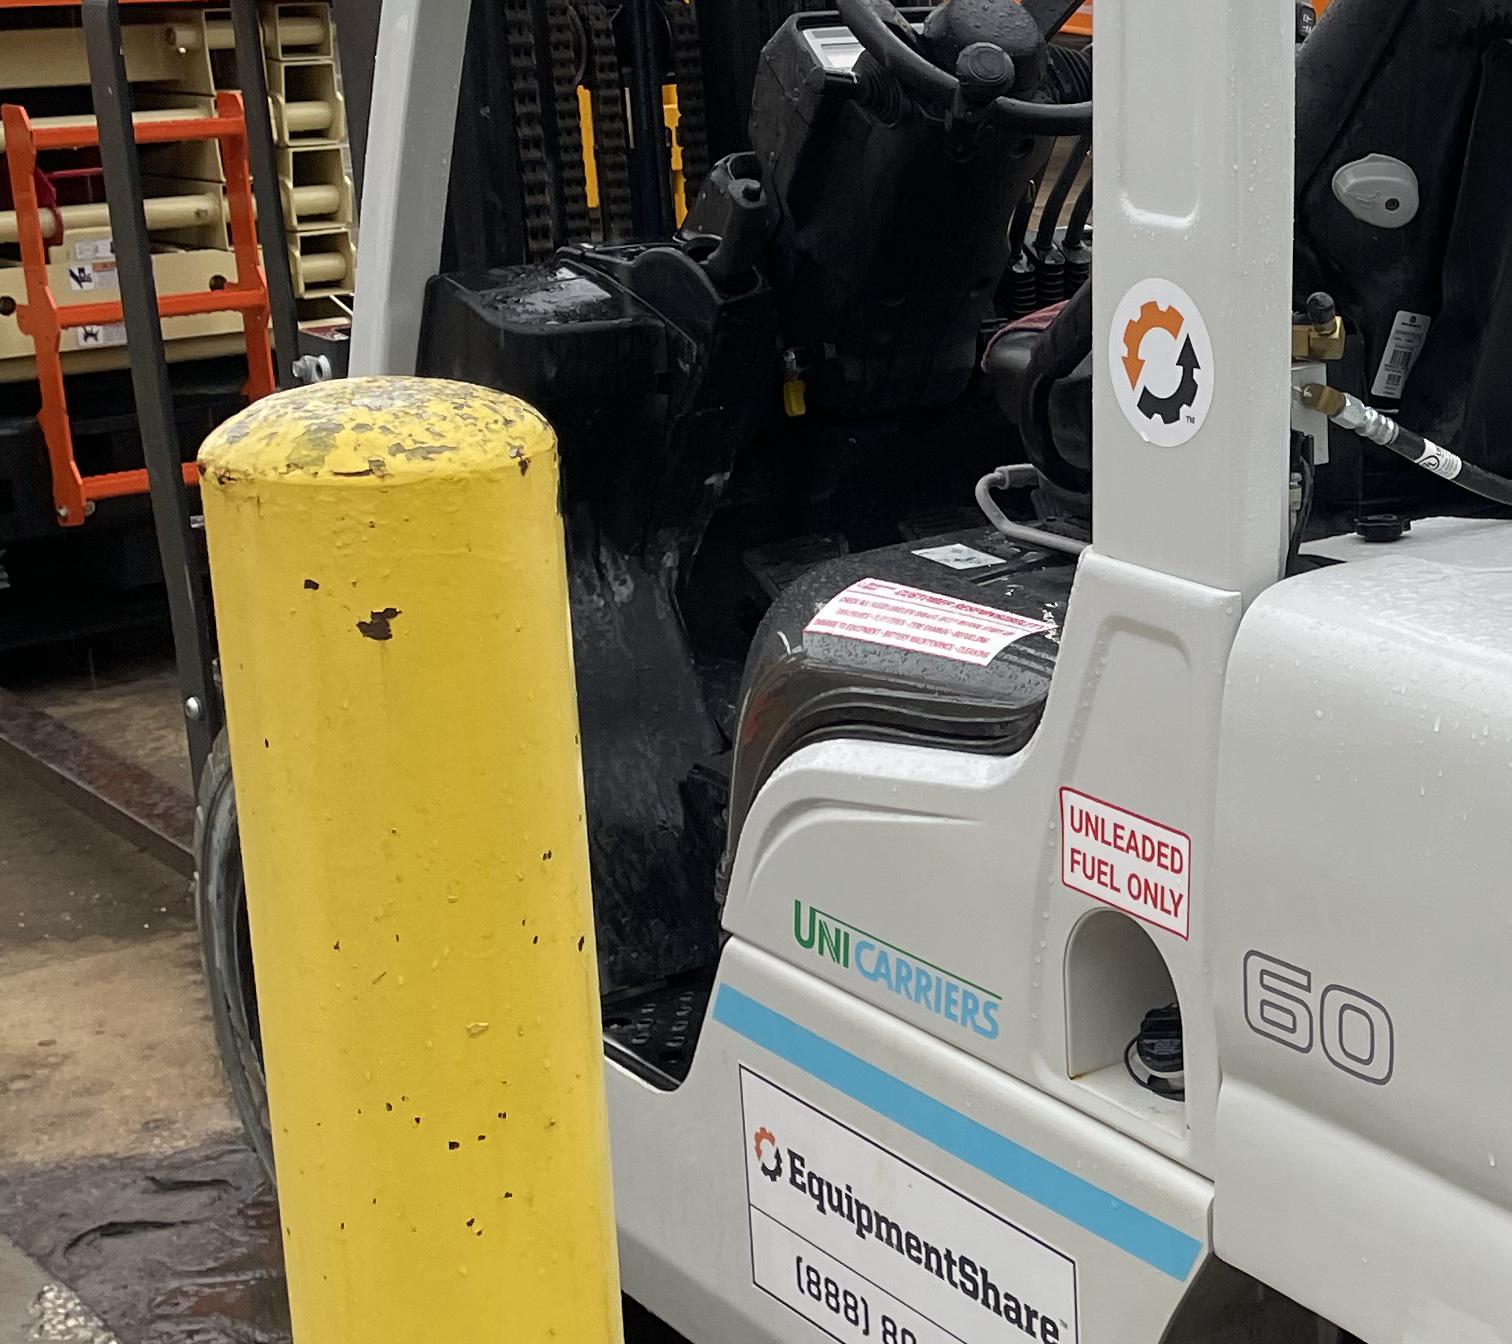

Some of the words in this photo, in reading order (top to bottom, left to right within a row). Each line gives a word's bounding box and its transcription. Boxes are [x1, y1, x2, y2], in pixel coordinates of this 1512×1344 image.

[1070, 804, 1184, 875] UNLEADED
[1070, 847, 1121, 894] FUEL
[1127, 872, 1184, 918] ONLY
[1243, 949, 1394, 1086] 60
[795, 1255, 870, 1337] (888)
